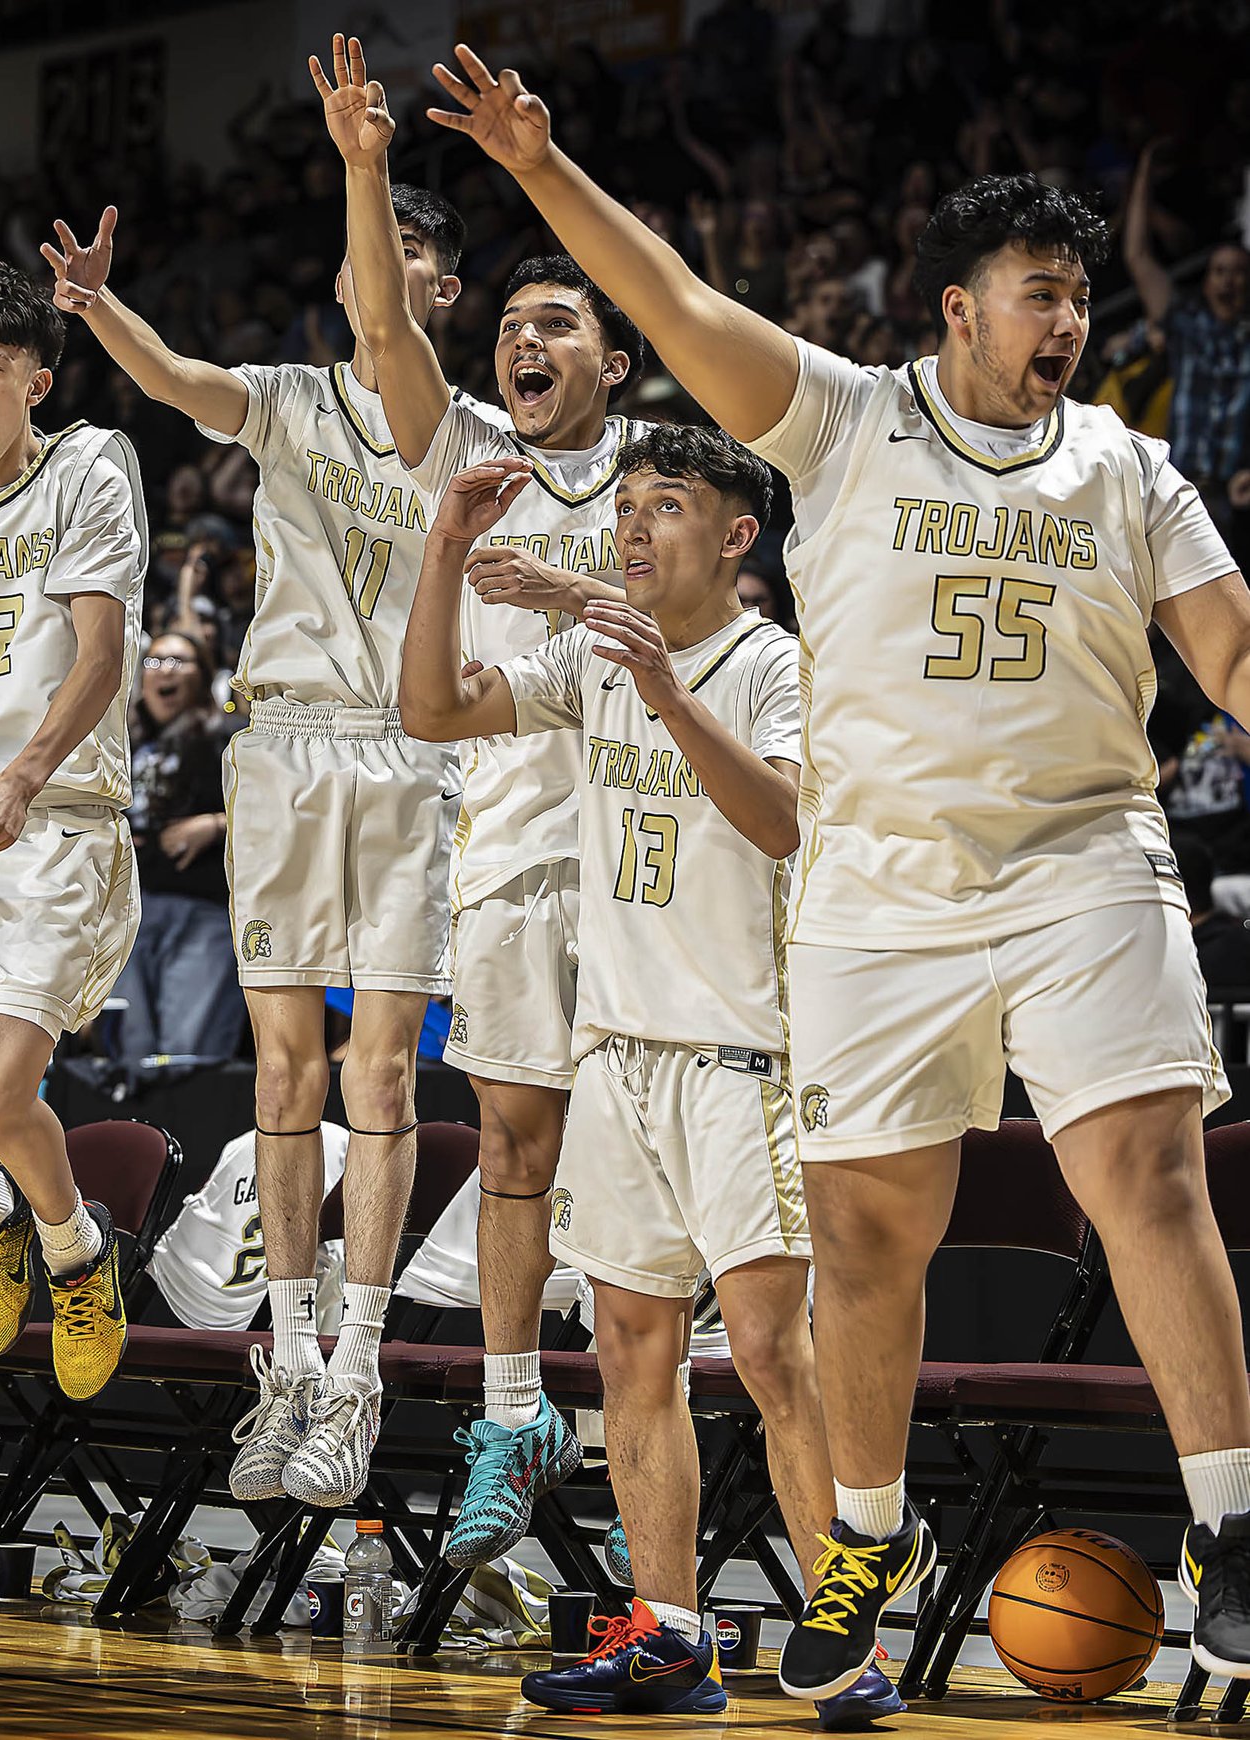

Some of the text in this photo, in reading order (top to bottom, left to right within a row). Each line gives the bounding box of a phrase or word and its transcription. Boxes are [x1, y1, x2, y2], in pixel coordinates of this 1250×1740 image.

[307, 449, 428, 534] TROJAN
[893, 497, 1098, 571] TROJANS
[342, 526, 393, 621] 11
[923, 574, 1057, 682] 55
[588, 735, 711, 798] TROJAN
[612, 808, 679, 908] 13
[754, 1056, 765, 1069] M
[233, 1174, 257, 1206] GA
[347, 1592, 364, 1618] G
[716, 1630, 740, 1639] PEPSI
